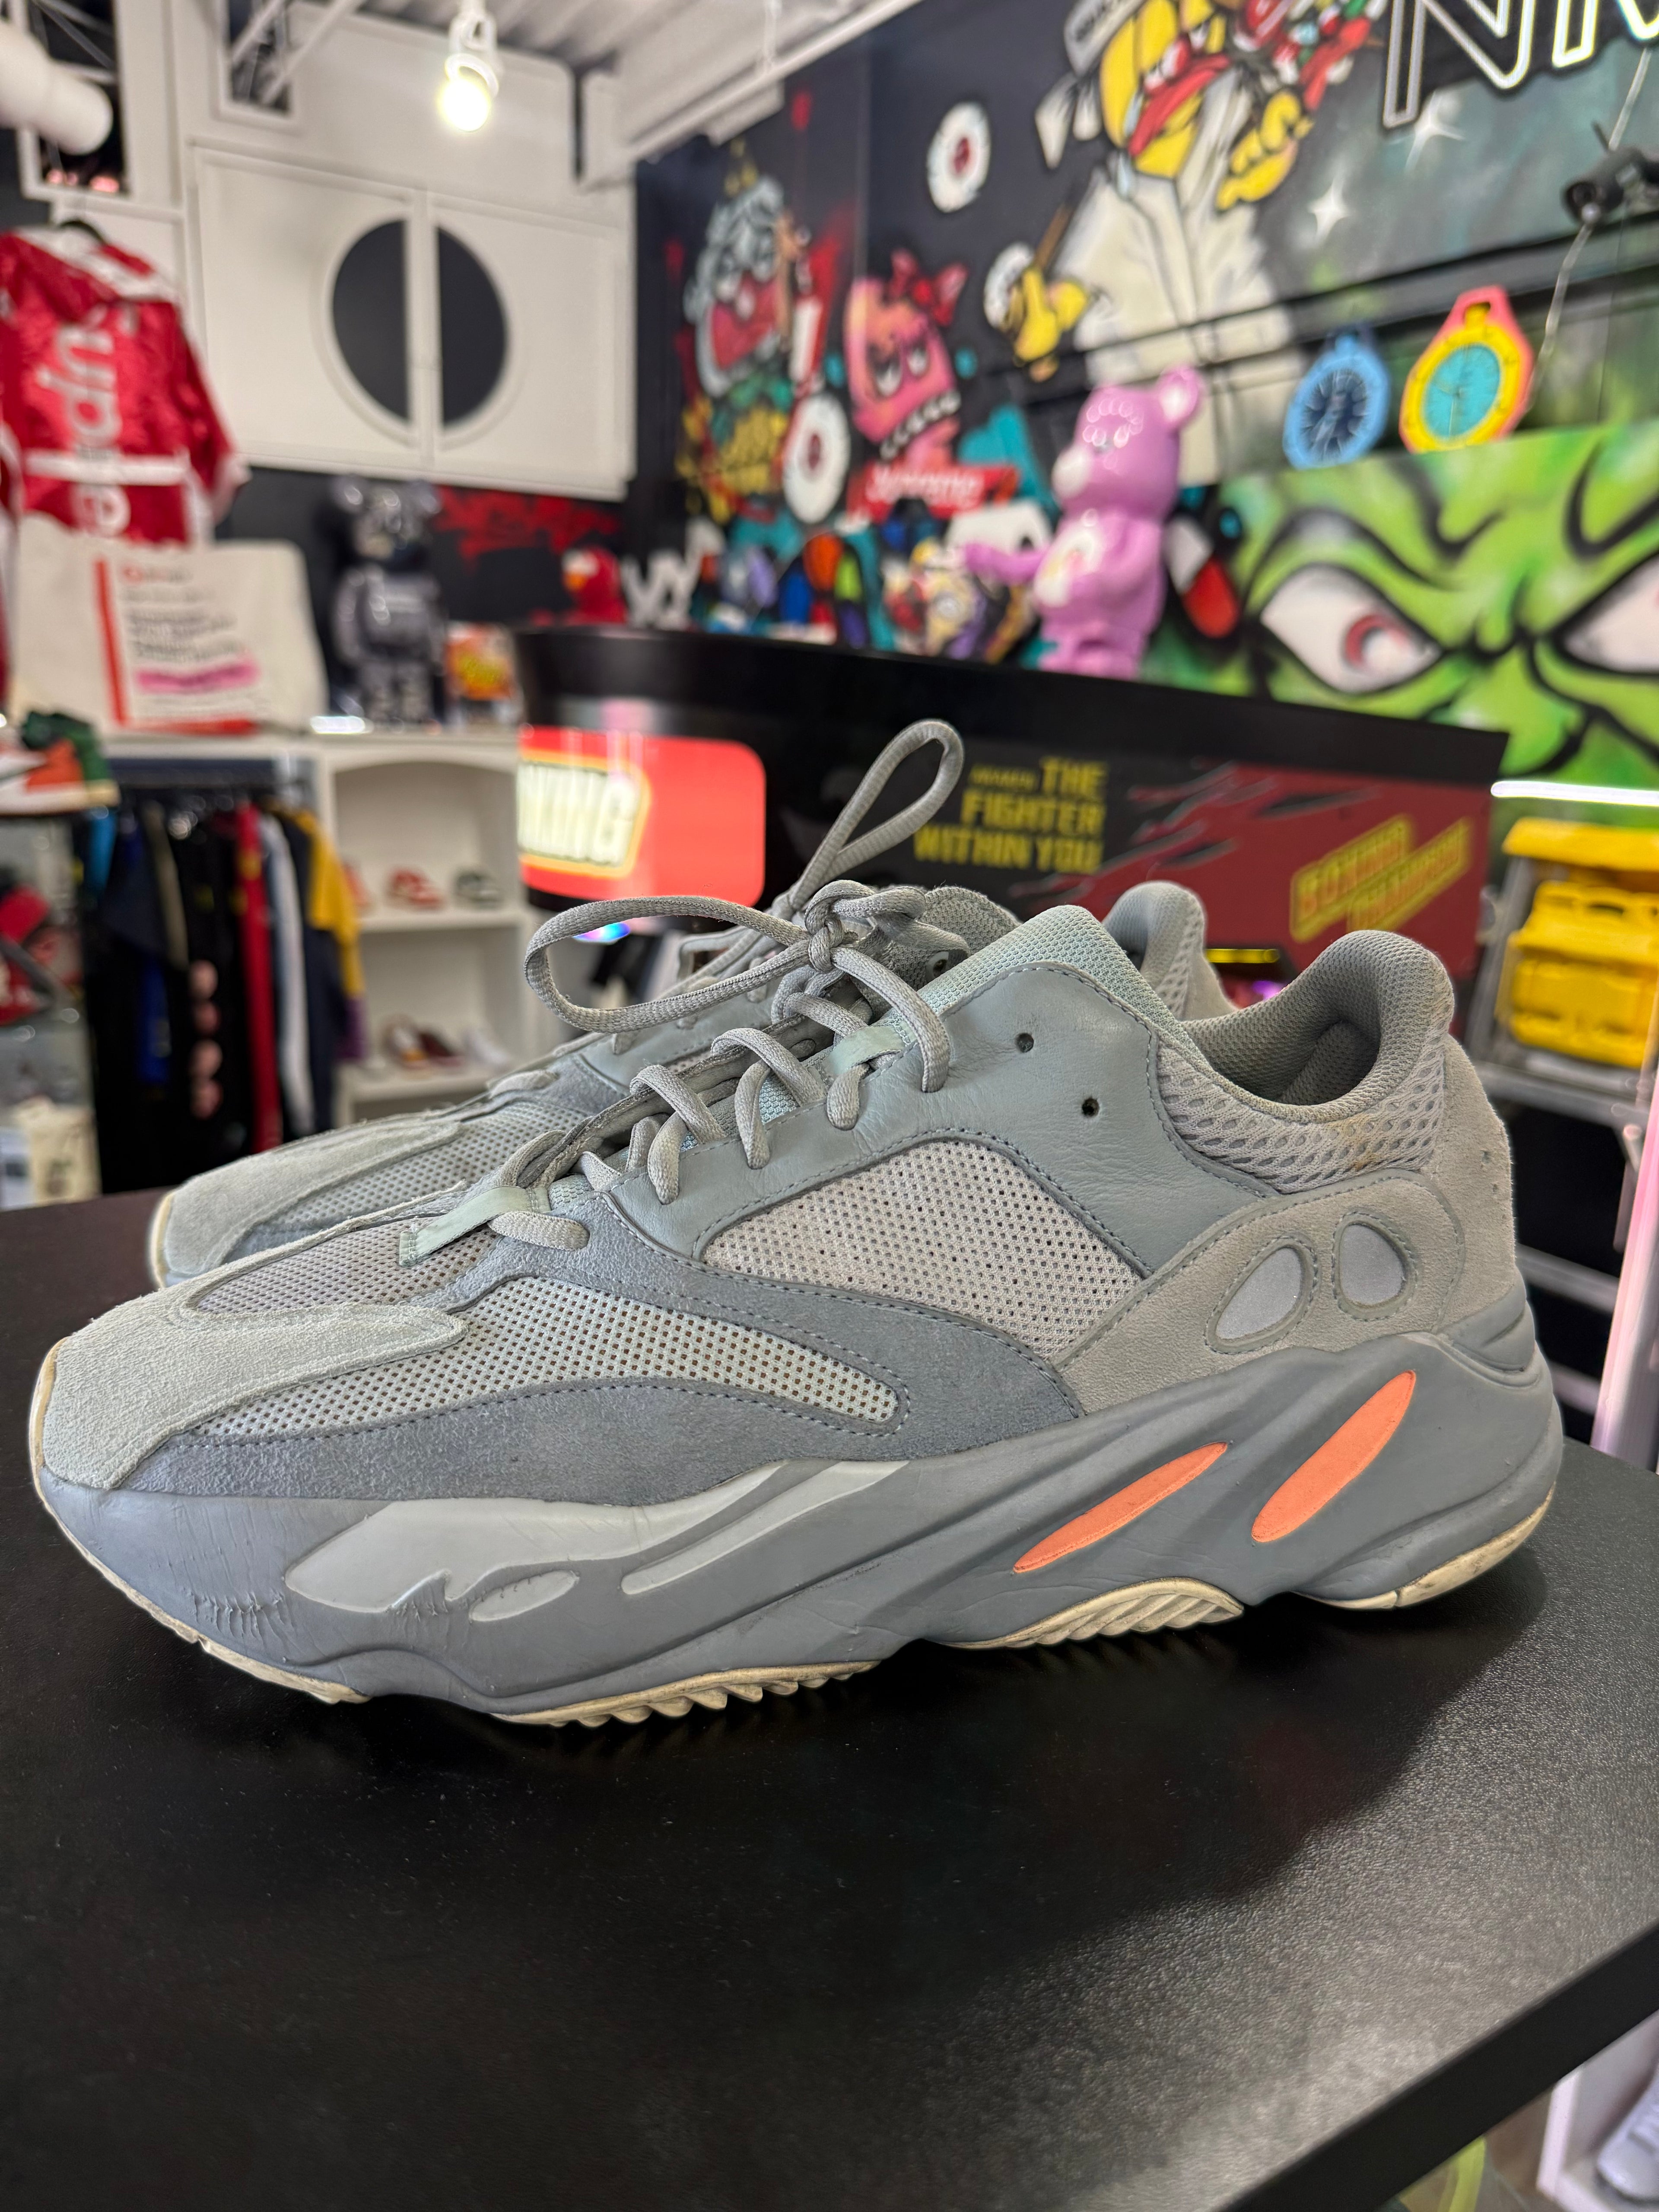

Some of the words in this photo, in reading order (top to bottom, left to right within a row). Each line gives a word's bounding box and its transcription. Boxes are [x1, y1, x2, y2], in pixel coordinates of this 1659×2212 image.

[1042, 758, 1105, 796] THE
[963, 791, 1105, 835] FIGHTER
[915, 824, 1031, 868] WITHIN
[1038, 838, 1102, 874] YOU
